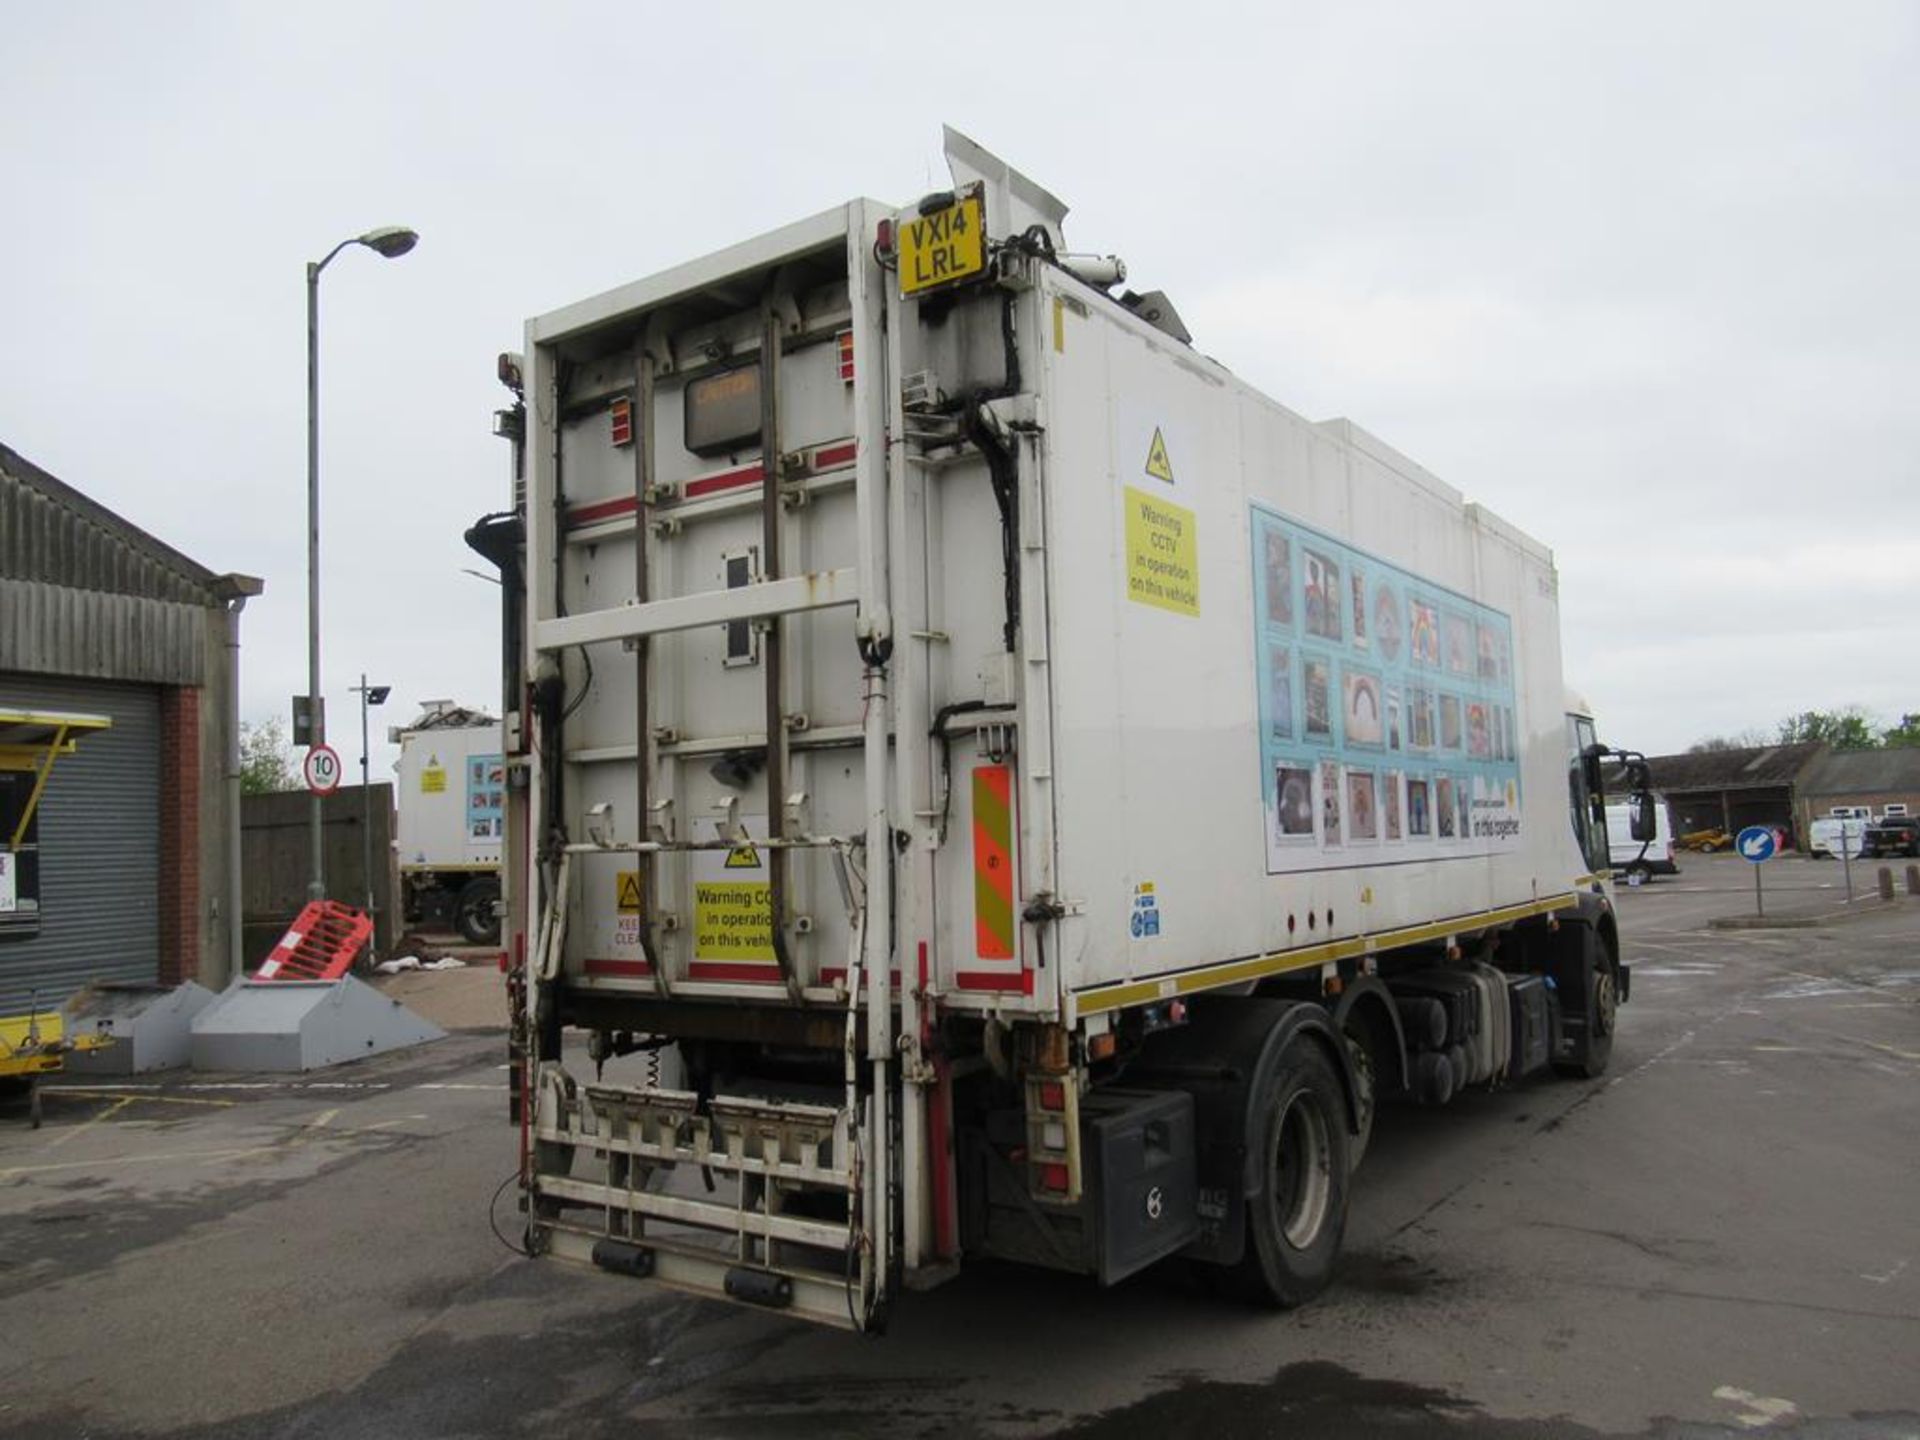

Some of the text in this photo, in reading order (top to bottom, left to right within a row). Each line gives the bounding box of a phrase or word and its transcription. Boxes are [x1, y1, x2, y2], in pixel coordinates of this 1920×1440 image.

[911, 207, 967, 250] VX14
[915, 244, 966, 282] LRL
[1141, 503, 1182, 537] Warning
[1150, 531, 1177, 553] CCTV
[1136, 553, 1190, 581] in operation
[1131, 575, 1196, 607] on this vehicle
[313, 755, 334, 776] 10
[697, 889, 772, 908] Warning CC
[618, 918, 639, 931] KEE
[707, 912, 773, 928] in operatio
[699, 935, 715, 946] on
[718, 933, 742, 947] this
